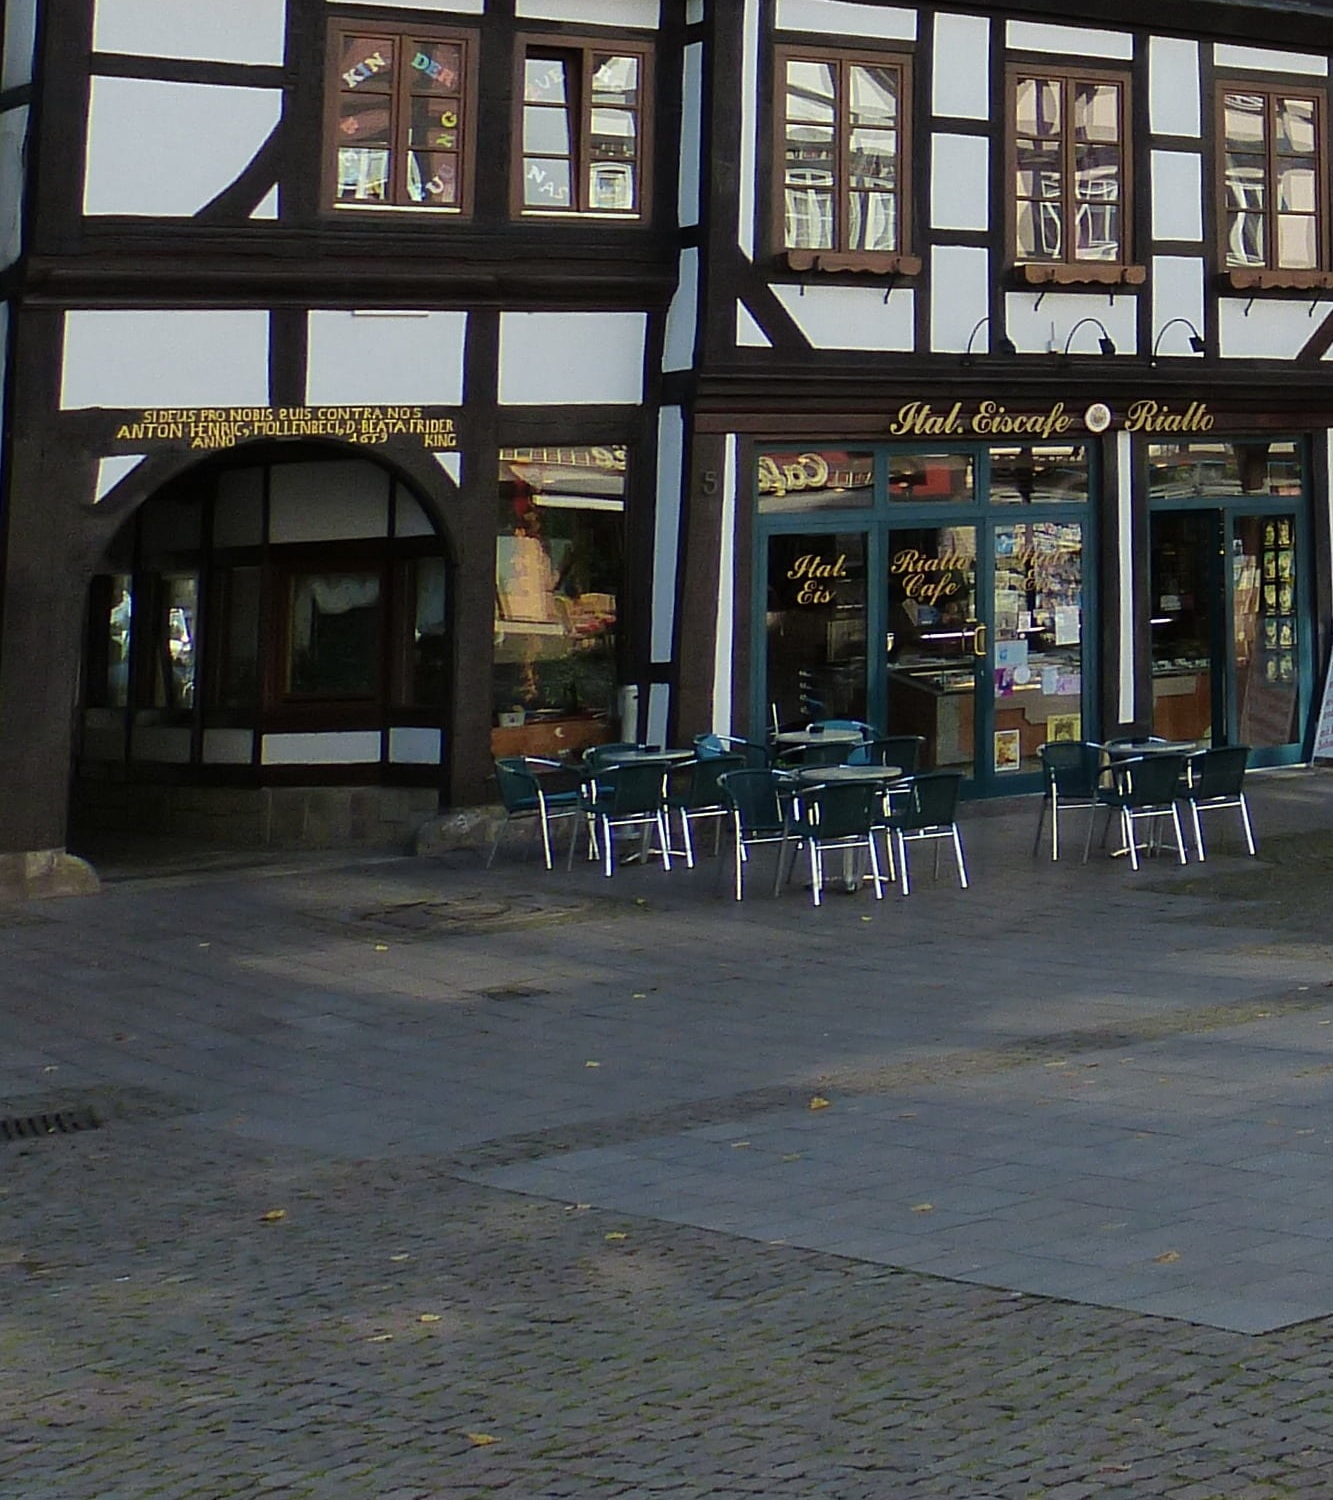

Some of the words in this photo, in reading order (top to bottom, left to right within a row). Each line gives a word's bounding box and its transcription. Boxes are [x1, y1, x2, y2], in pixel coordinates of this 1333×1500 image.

[159, 409, 197, 423] DEUS
[200, 409, 226, 421] PRO
[229, 408, 274, 421] NOBIS
[317, 407, 382, 420] CONTRA
[387, 407, 423, 419] NOS
[889, 401, 965, 436] Ital.
[970, 399, 1073, 438] Eiscafe
[1123, 399, 1216, 434] Rialto
[116, 423, 183, 439] ANTON
[191, 434, 236, 449] ANNO
[423, 433, 457, 448] KING
[702, 471, 719, 496] 5
[787, 553, 847, 581] Ital.
[890, 548, 974, 575] Rialto
[796, 580, 837, 605] Eis
[902, 574, 961, 606] Cafe
